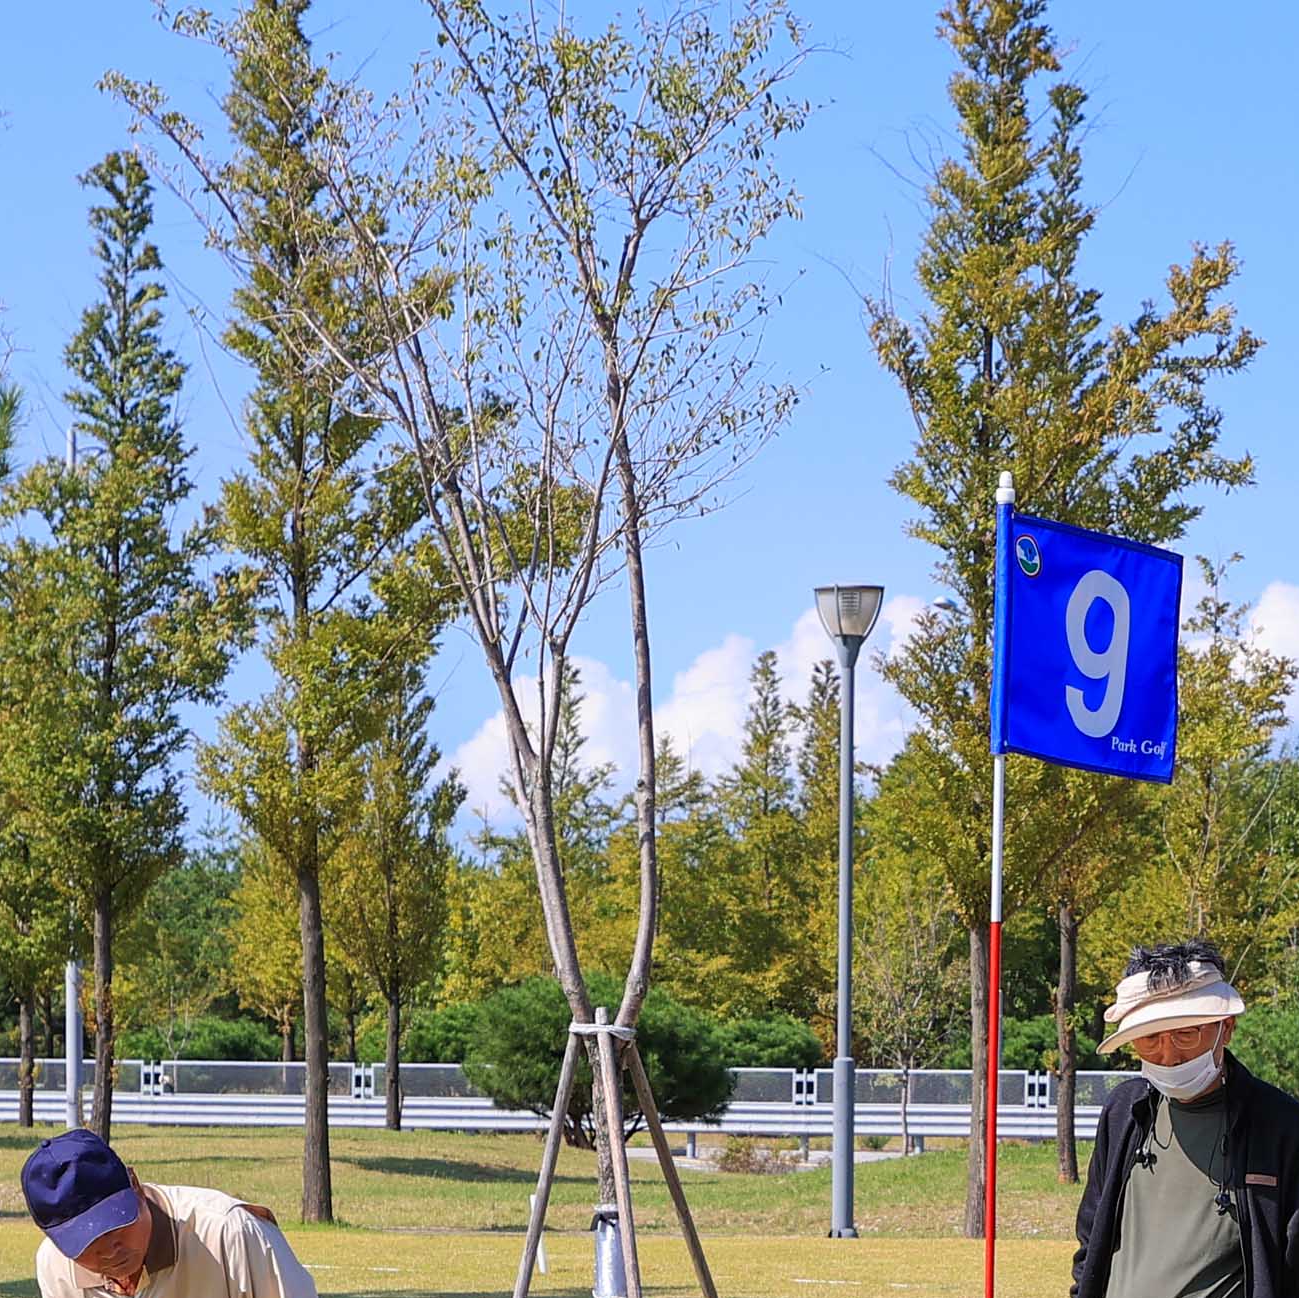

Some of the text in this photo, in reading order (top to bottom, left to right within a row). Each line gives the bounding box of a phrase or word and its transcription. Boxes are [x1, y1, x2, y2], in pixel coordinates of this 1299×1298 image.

[1066, 569, 1130, 738] 9
[1111, 736, 1168, 760] Park Golf
